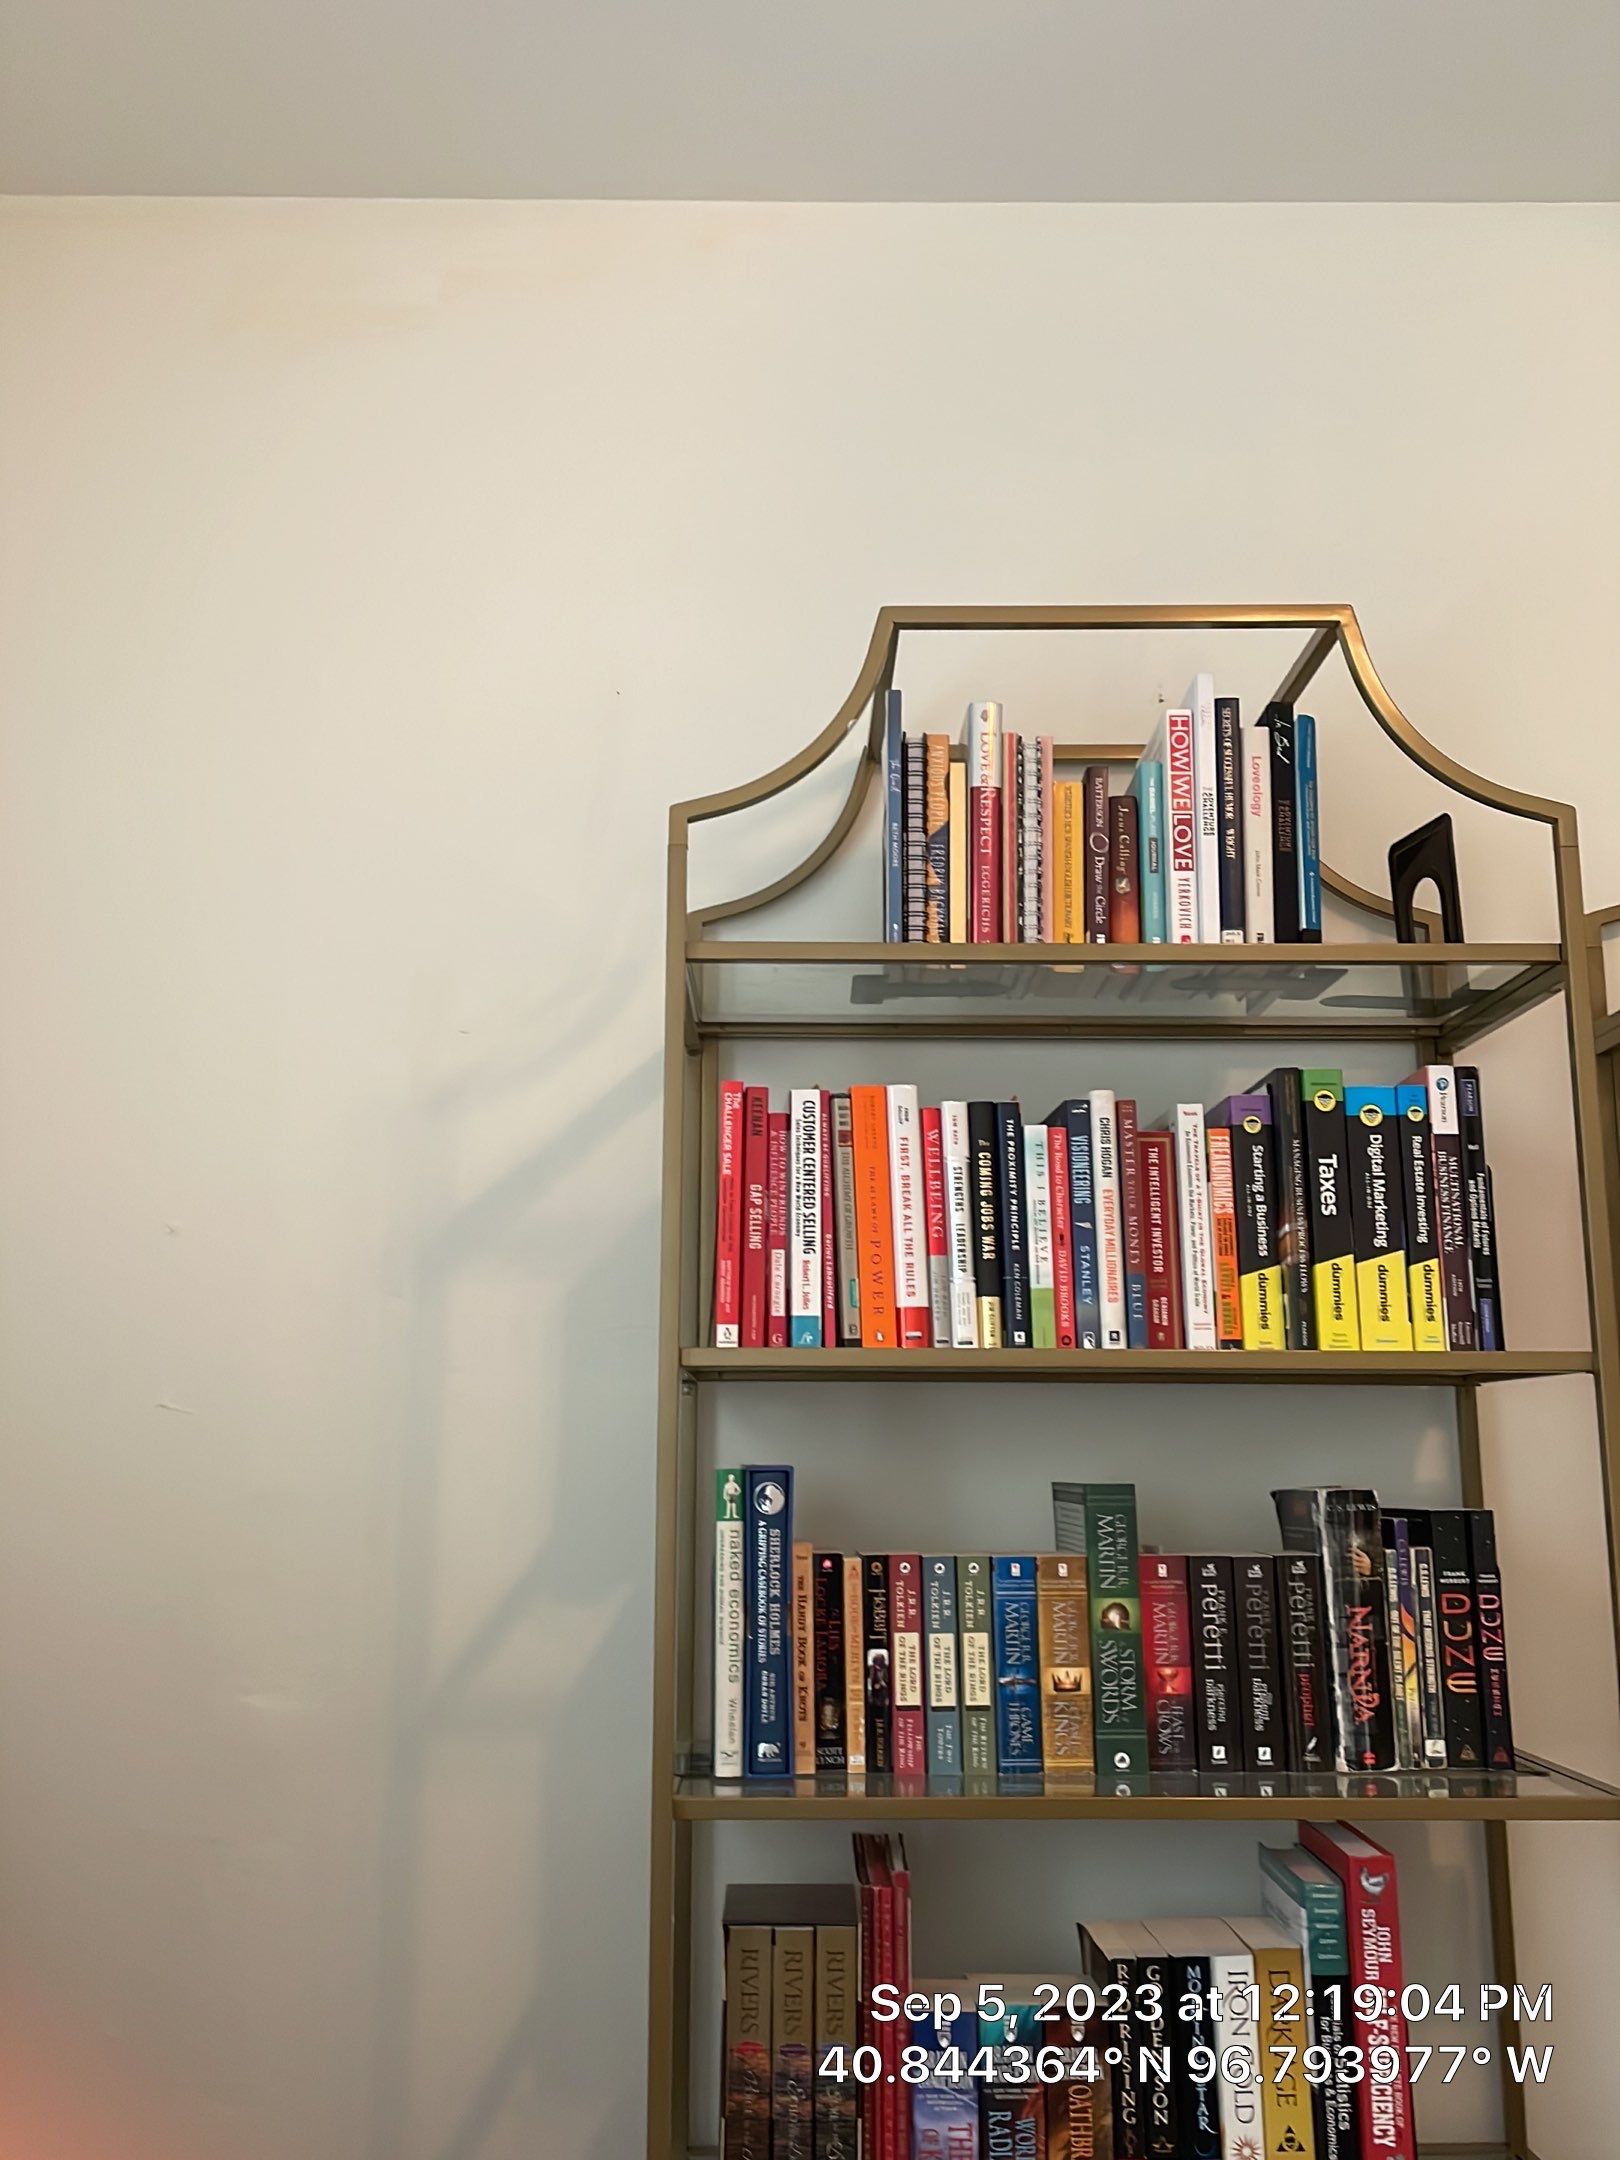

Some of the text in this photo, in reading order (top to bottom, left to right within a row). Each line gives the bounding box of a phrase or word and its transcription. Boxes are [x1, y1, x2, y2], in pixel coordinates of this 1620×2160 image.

[929, 744, 945, 827] ANXIOUS PEOPLE
[1095, 778, 1104, 828] BATTERSON
[1170, 715, 1193, 870] HOW WE LOVE
[1251, 755, 1263, 817] Loveology
[1116, 805, 1131, 874] Jesus Calling
[1226, 828, 1236, 860] WRIGHT
[981, 865, 991, 933] EGGERICHS
[1178, 877, 1191, 930] YERKOVICH
[722, 1092, 733, 1150] CHALLENGER
[732, 1092, 742, 1108] The
[751, 1096, 764, 1137] KEENAN
[1439, 1091, 1448, 1123] Pearson
[1465, 1083, 1474, 1112] PEARSON
[722, 1152, 732, 1175] SALE
[802, 1100, 817, 1255] CUSTOMER CENTERED SELLING
[1035, 1142, 1045, 1177] THIS
[1071, 1135, 1091, 1204] VISIONEERING
[1099, 1117, 1113, 1178] CHRIS HOGAN
[1210, 1135, 1234, 1214] FREAKONOMICS
[1250, 1144, 1266, 1192] Starting
[927, 1129, 944, 1239] WELLBEING
[978, 1151, 996, 1260] COMING JOBS WAR
[1005, 1119, 1020, 1251] THE PROXIMITY PRINCIPLE
[1053, 1133, 1066, 1230] The Road to Character
[1122, 1119, 1140, 1265] MASTER YOUR MONEY
[1147, 1147, 1164, 1273] THE INTELLIGENT INVESTOR
[1317, 1153, 1338, 1216] Taxes
[1366, 1134, 1390, 1248] Digital Marketing
[1411, 1135, 1430, 1244] Real Estate Investing
[1437, 1150, 1454, 1254] BUSINESS FINANCE
[1449, 1156, 1464, 1249] MULTINATIONAL
[1476, 1172, 1490, 1255] Fundamentals of Futures
[749, 1184, 763, 1250] GAP SELLING
[899, 1136, 916, 1298] FIRST, BREAK ALL THE RULES
[953, 1166, 967, 1273] STRENGTHS LEADERSHIP
[1038, 1200, 1048, 1264] BELIEVE
[1255, 1204, 1270, 1257] Business
[1468, 1179, 1482, 1249] and Options Markets
[1080, 1245, 1093, 1306] STANLEY
[1102, 1189, 1119, 1304] EVERYDAY MILLIONAIRES
[1013, 1263, 1023, 1320] KEN COLEMAN
[1058, 1250, 1071, 1327] DAVID BROOKS
[1131, 1284, 1143, 1320] BLUE
[1152, 1296, 1169, 1326] BENJAMIN GRAHAM
[1257, 1272, 1271, 1330] dummies
[1331, 1263, 1345, 1320] dummies
[1377, 1264, 1392, 1321] dummies
[1422, 1264, 1437, 1321] dummies
[758, 1526, 768, 1568] GRIPPING
[1098, 1513, 1117, 1589] MARTIN
[728, 1528, 744, 1682] naked economics
[758, 1568, 768, 1614] CASEBOOK
[758, 1614, 768, 1626] OF
[769, 1527, 782, 1654] SHERLOCK HOLMES
[867, 1588, 887, 1642] HOBBIT
[895, 1578, 906, 1628] TOLKIEN
[908, 1588, 917, 1618] J.R.R.
[930, 1579, 941, 1629] TOLKIEN
[943, 1588, 952, 1619] J.R.R.
[964, 1579, 975, 1628] TOLKIEN
[758, 1627, 768, 1663] STORIES
[797, 1575, 808, 1722] THE HANDY BOOK OF KNOTS
[1004, 1600, 1021, 1664] MARTIN
[1052, 1600, 1067, 1664] MARTIN
[1152, 1601, 1168, 1664] MARTIN
[1201, 1582, 1226, 1670] Peretti
[1246, 1582, 1270, 1670] Peretti
[1289, 1580, 1315, 1669] Peretti
[899, 1634, 908, 1702] OF THE RINGS
[909, 1644, 918, 1692] THE LORD
[933, 1635, 943, 1703] OF THE RINGS
[943, 1645, 952, 1693] THE LORD
[967, 1635, 978, 1702] OF THE RINGS
[978, 1645, 987, 1692] THE LORD
[1099, 1639, 1121, 1724] SWORDS
[1118, 1646, 1138, 1711] STORM
[1346, 1604, 1381, 1724] NARNIA
[1008, 1701, 1023, 1755] THRONES
[1020, 1705, 1034, 1744] GAME
[1055, 1700, 1070, 1755] KINGS
[1157, 1699, 1171, 1754] CROWS
[1361, 1908, 1379, 1980] SEYMOUR
[1376, 1926, 1392, 1963] JOHN
[741, 1948, 760, 2033] RIVERS
[784, 1949, 803, 2035] RIVERS
[826, 1949, 845, 2035] RIVERS
